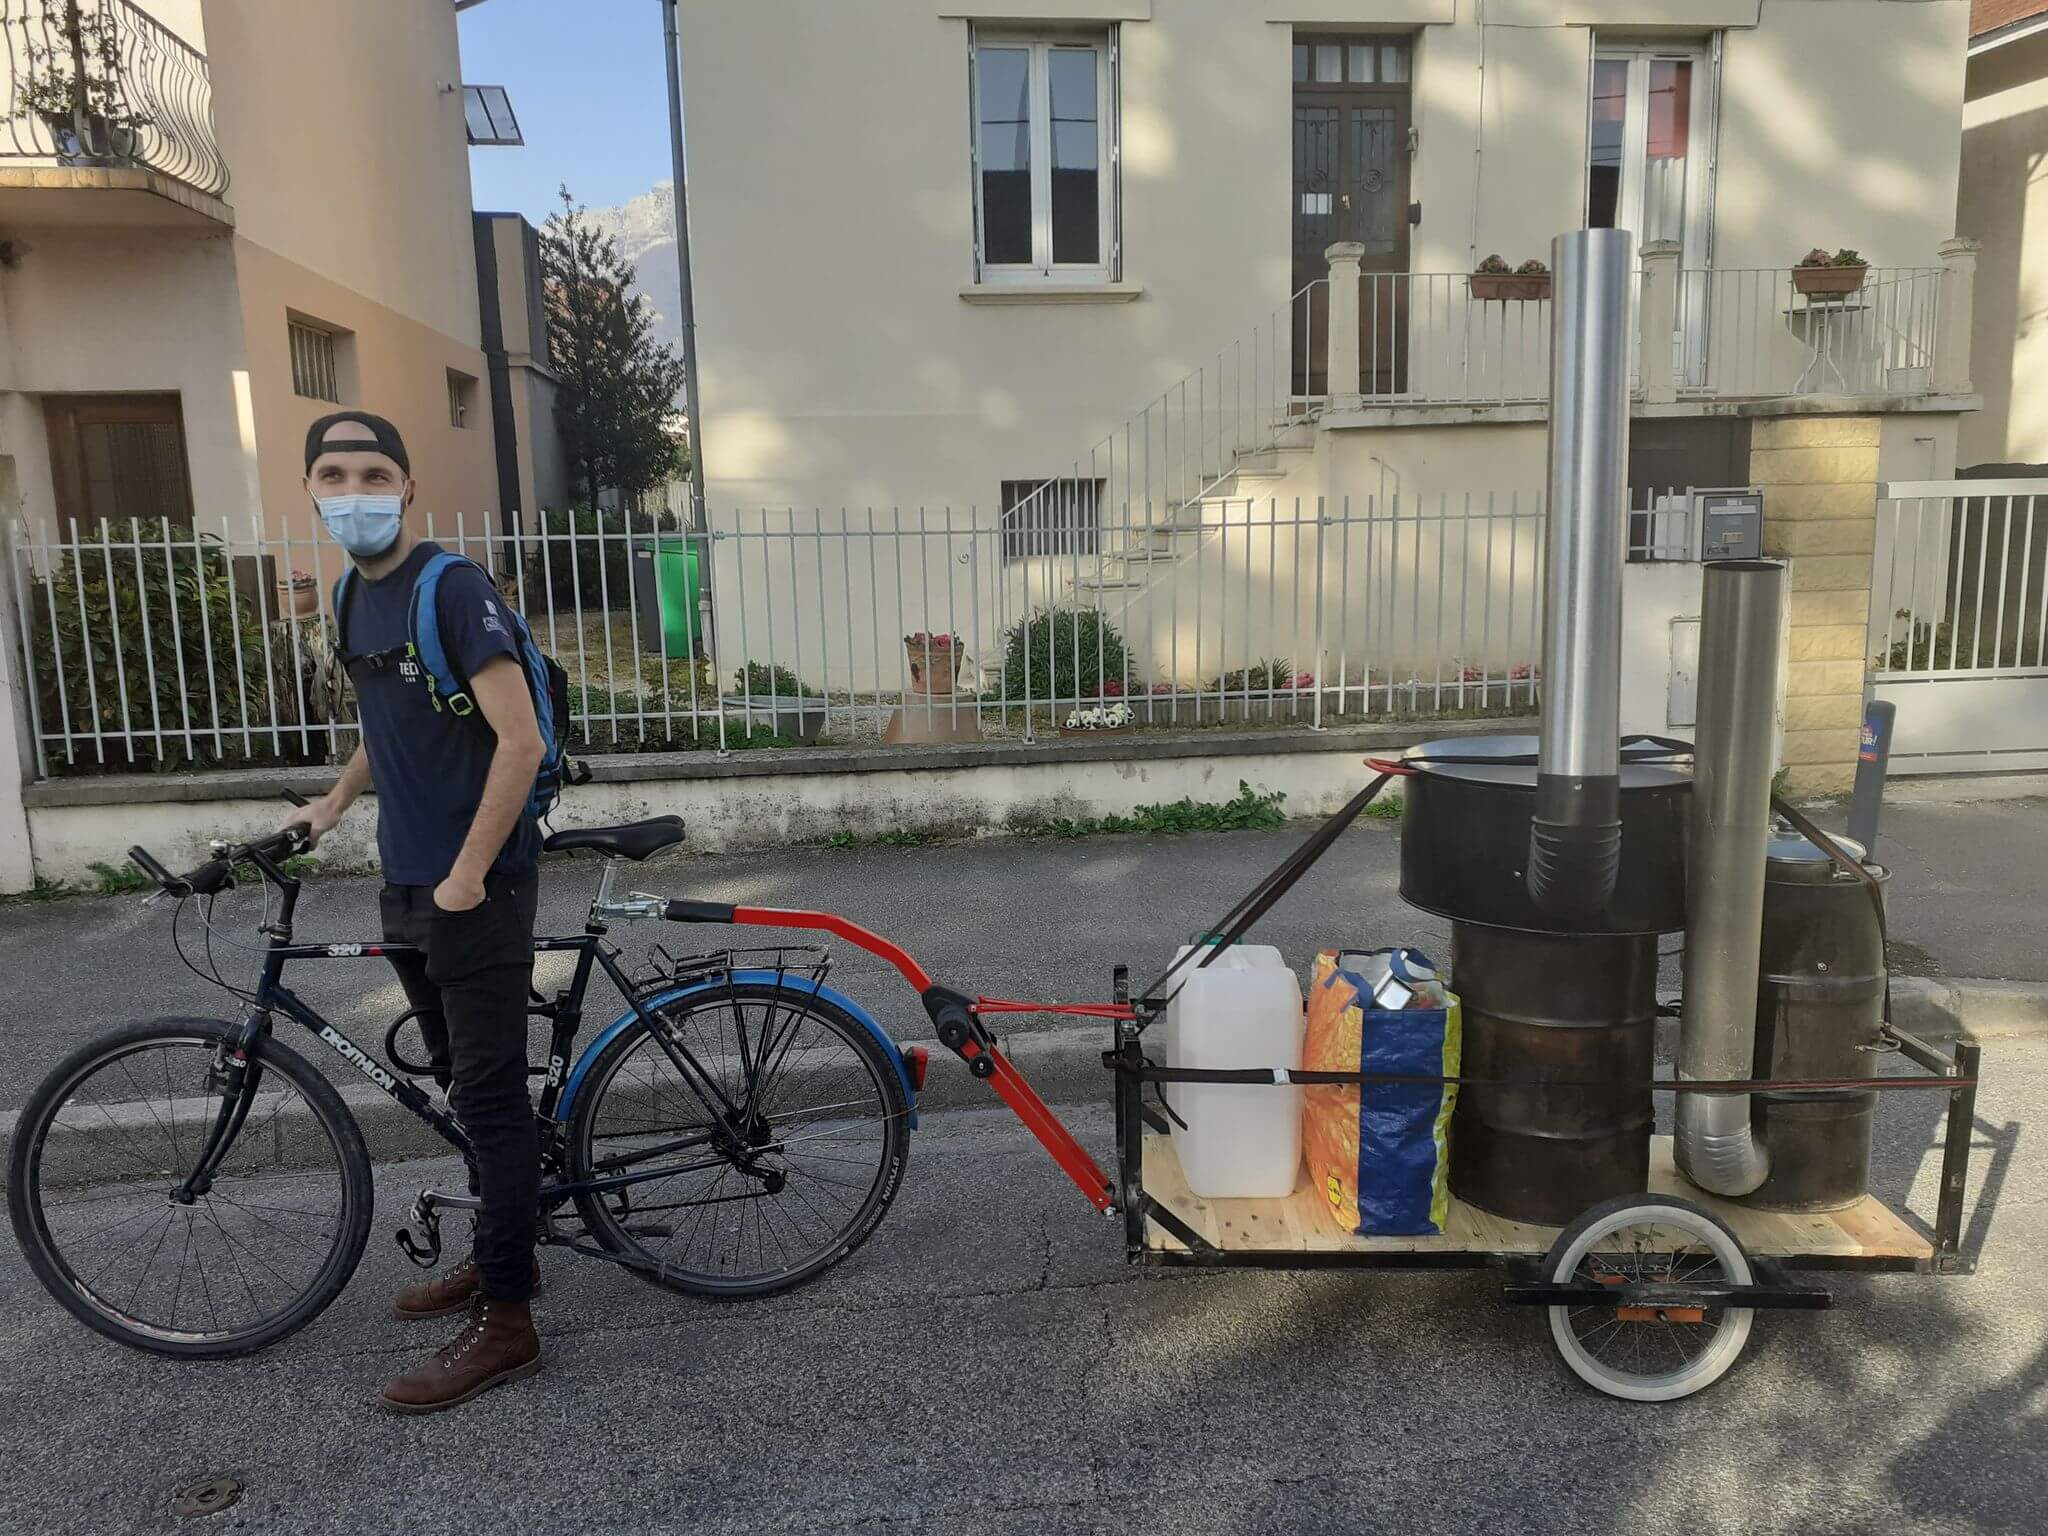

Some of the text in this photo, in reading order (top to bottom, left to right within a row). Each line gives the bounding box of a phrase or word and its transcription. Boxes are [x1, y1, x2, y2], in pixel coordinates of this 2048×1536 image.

[327, 943, 362, 957] 320
[319, 1025, 396, 1090] DECATHLON
[547, 1055, 564, 1087] 320
